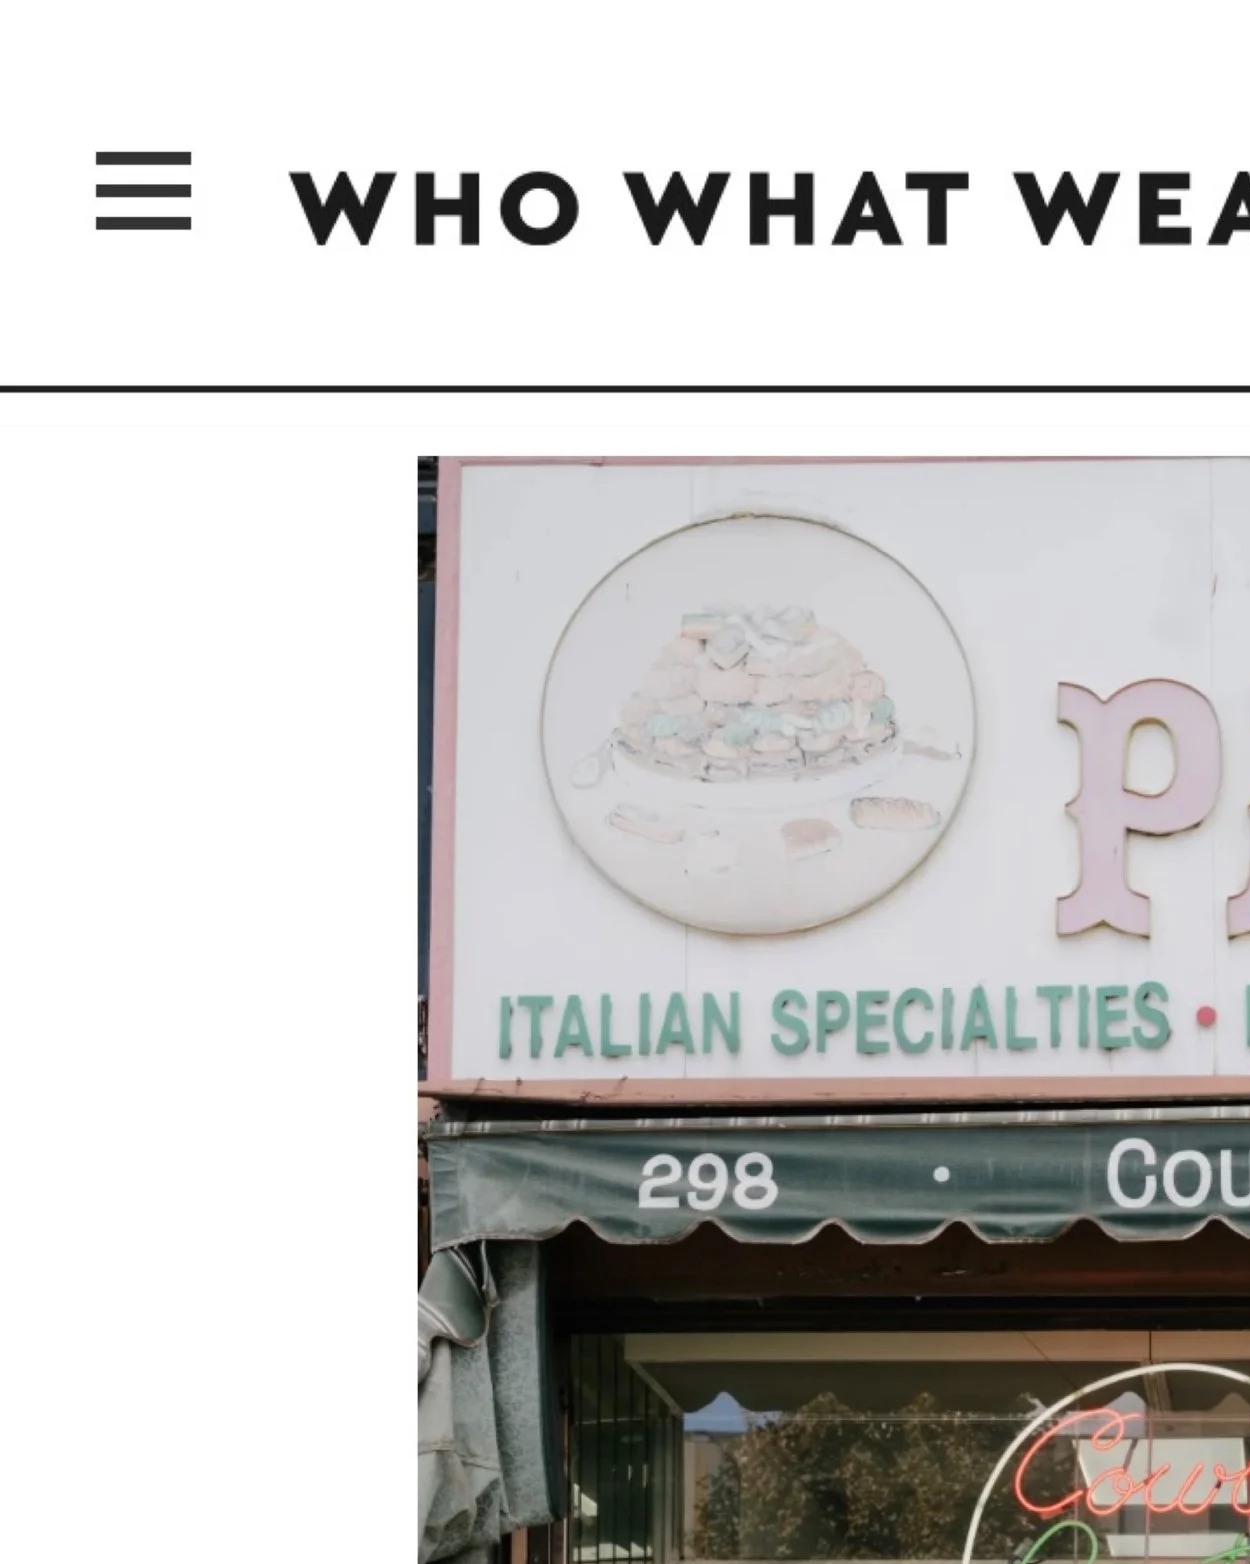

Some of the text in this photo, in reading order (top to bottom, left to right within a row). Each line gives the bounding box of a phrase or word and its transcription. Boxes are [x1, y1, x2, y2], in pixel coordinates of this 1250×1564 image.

[498, 990, 742, 1060] ITALIAN
[770, 980, 1172, 1056] SPECIALTIES
[637, 1152, 780, 1211] 298
